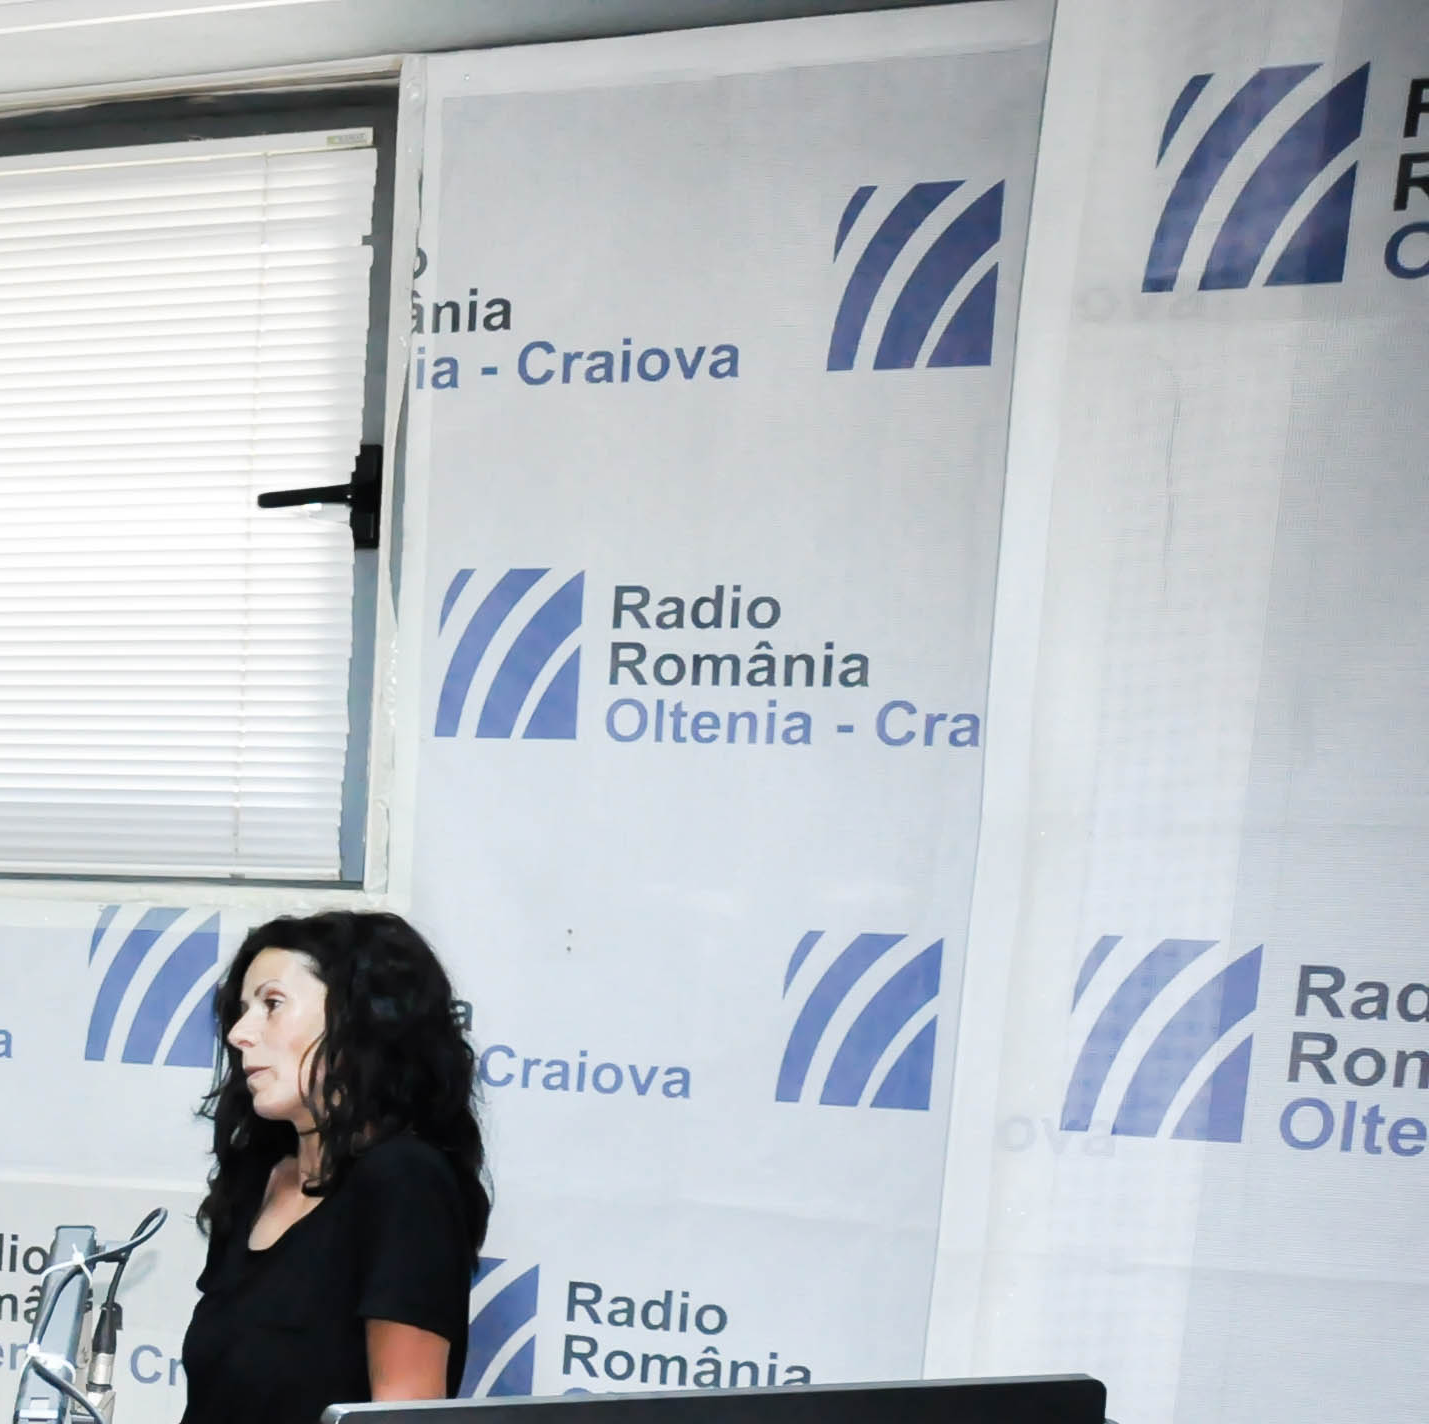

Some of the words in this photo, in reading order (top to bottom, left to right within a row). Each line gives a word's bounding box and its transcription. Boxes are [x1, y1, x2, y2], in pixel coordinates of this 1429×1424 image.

[517, 337, 740, 387] Craiova
[611, 584, 782, 630] Radio
[608, 640, 870, 688] România
[605, 697, 813, 745] Oltenia
[478, 1043, 692, 1099] Craiova
[1279, 1097, 1429, 1158] Olte
[565, 1280, 729, 1336] Radio
[561, 1333, 812, 1389] România
